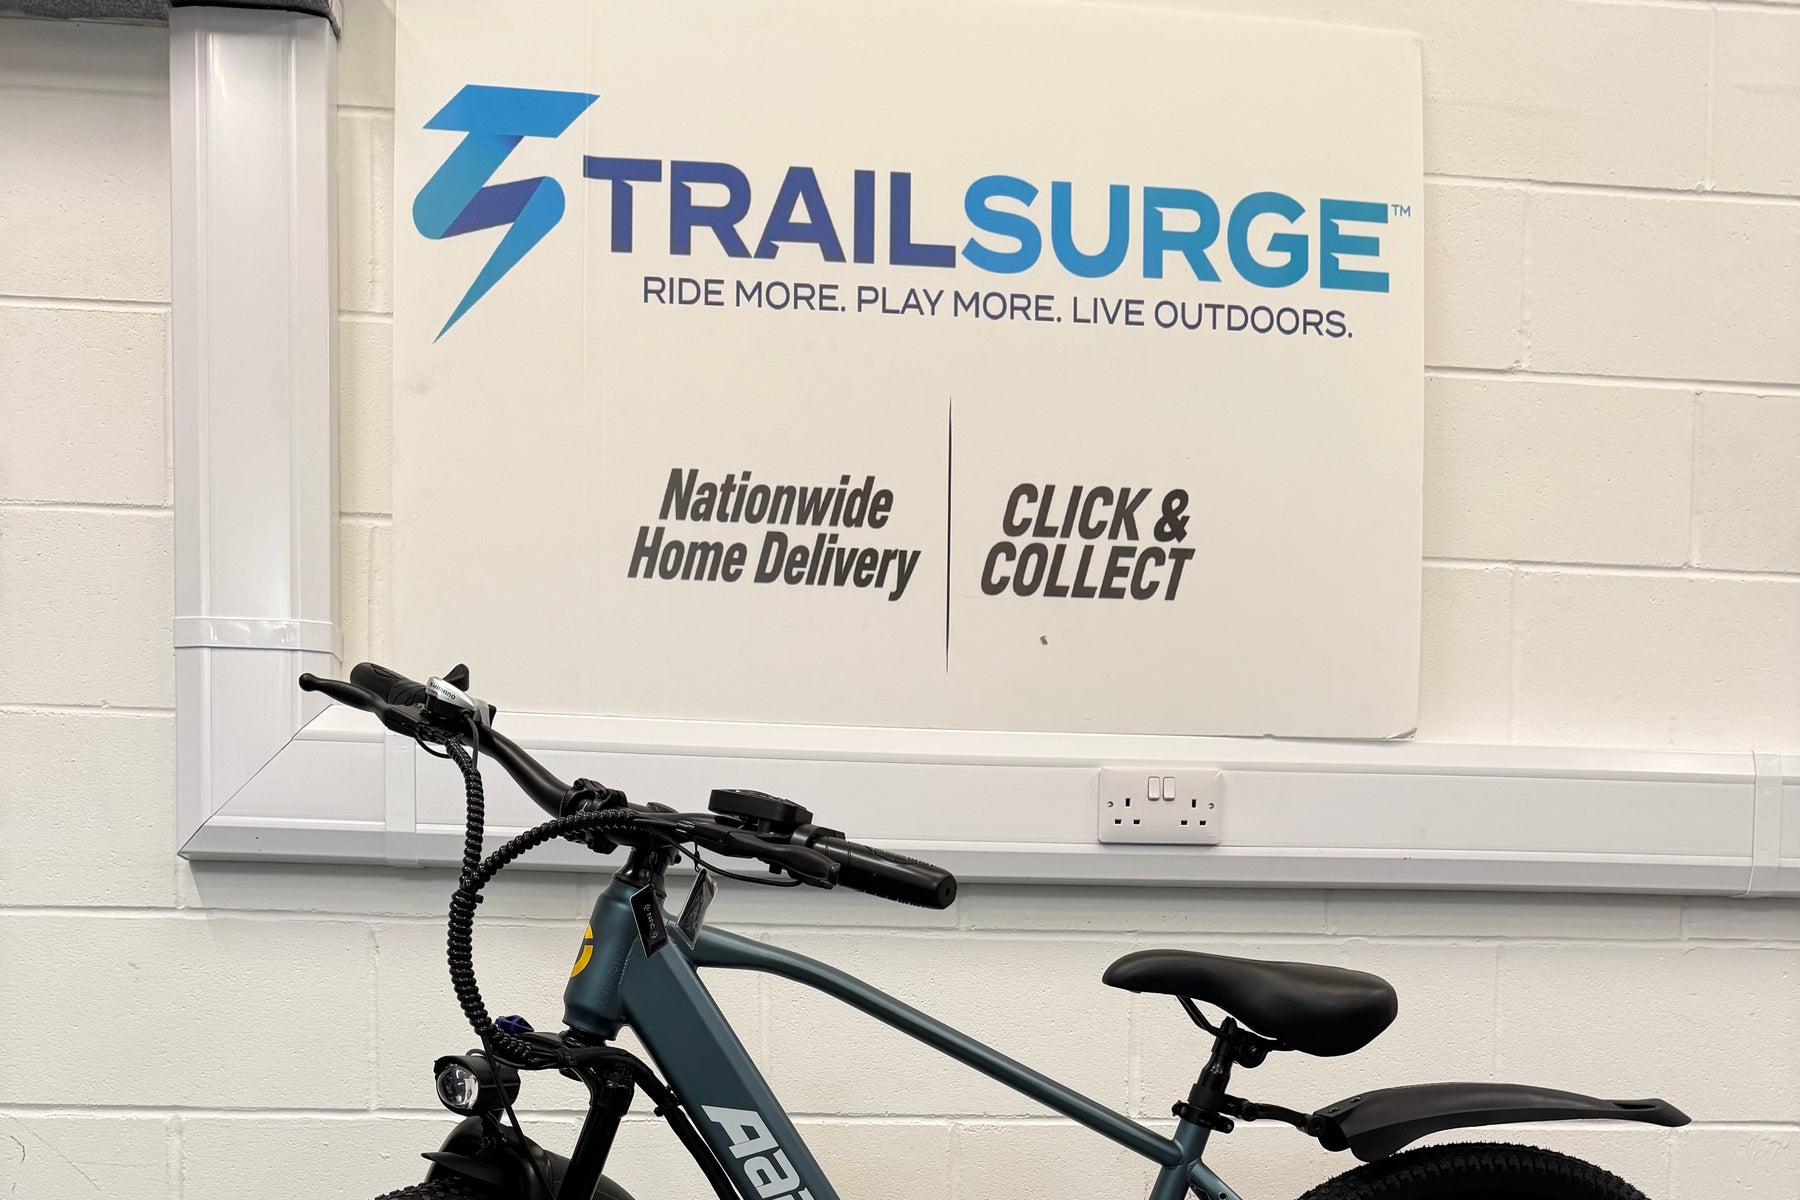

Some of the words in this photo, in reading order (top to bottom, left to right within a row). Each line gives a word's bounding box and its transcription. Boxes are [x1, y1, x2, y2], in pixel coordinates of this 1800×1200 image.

[582, 154, 1390, 293] TRAILSURGE
[643, 276, 725, 307] RIDE
[735, 280, 846, 313] MORE.
[857, 285, 944, 316] PLAY
[953, 290, 1062, 323] MORE.
[1073, 296, 1145, 326] LIVE
[1154, 300, 1353, 338] OUTDOORS.
[658, 467, 894, 529] Nationwide
[1002, 482, 1153, 541] CLICK
[1153, 488, 1191, 544] &
[627, 525, 748, 583] Home
[753, 530, 922, 602] Delivery
[980, 540, 1196, 601] COLLECT
